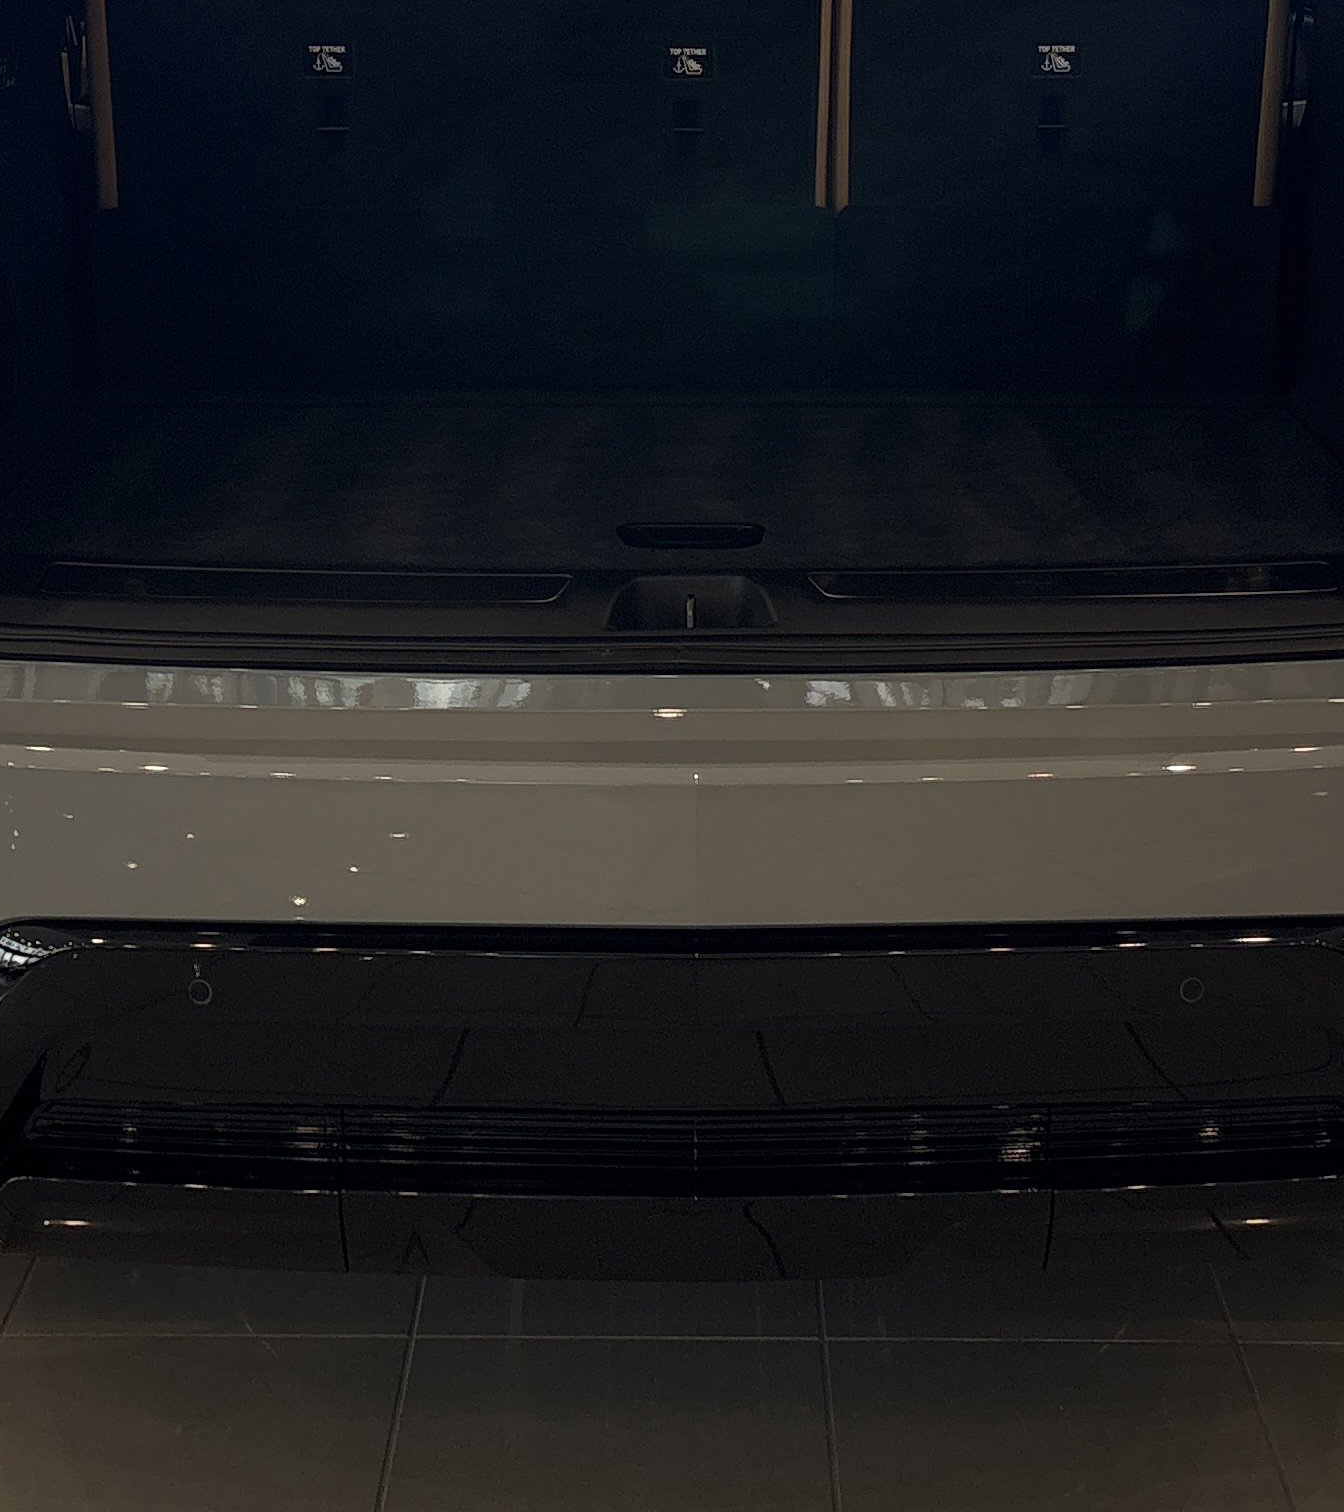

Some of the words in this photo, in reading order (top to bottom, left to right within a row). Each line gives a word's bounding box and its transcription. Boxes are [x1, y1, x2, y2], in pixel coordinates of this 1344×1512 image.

[308, 45, 321, 53] TOP
[322, 45, 346, 53] TETHER
[669, 48, 682, 56] TOP
[683, 48, 707, 56] TETHER
[1038, 45, 1051, 53] TOP
[1052, 45, 1076, 53] TETHER
